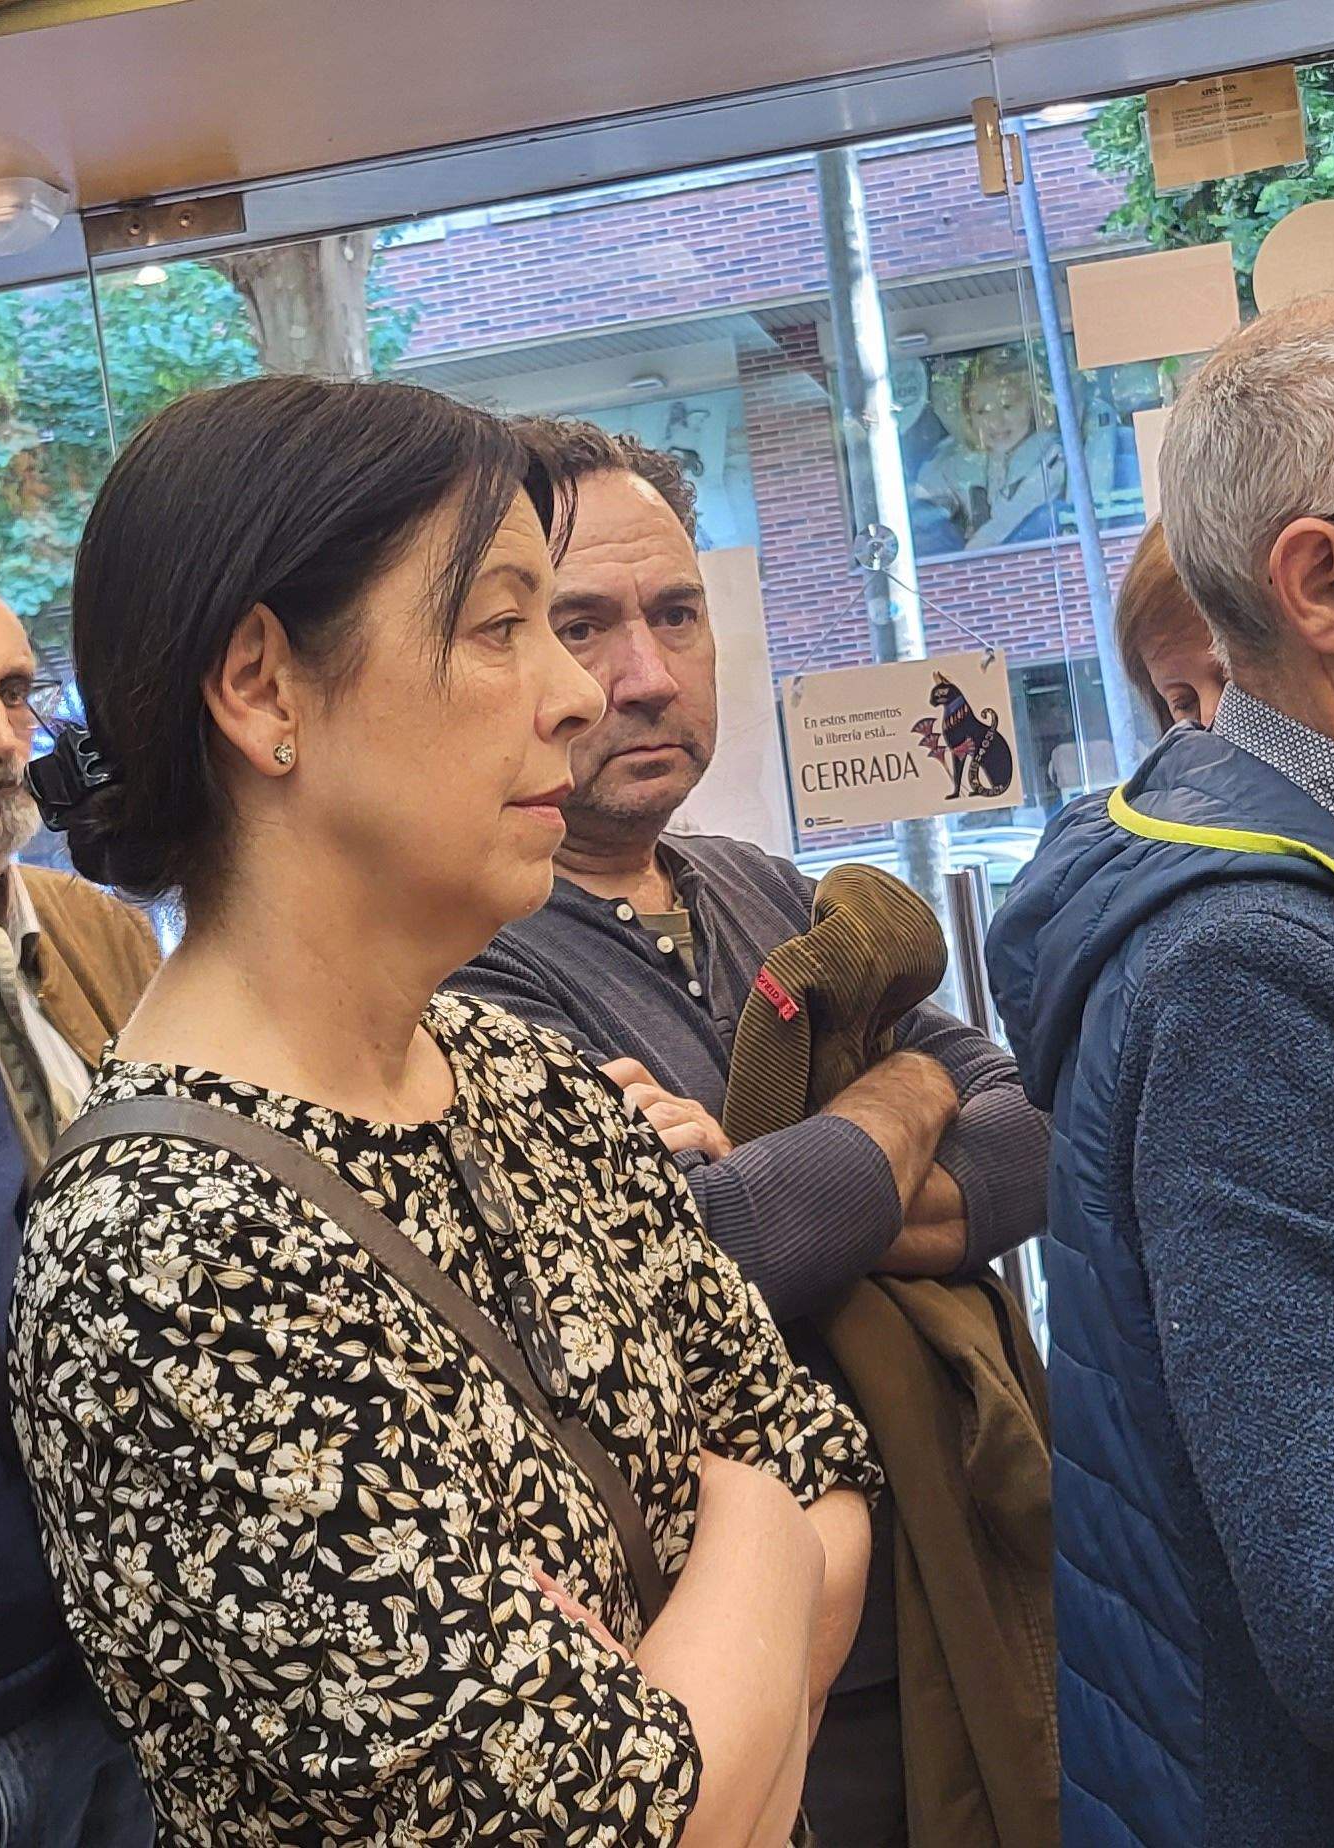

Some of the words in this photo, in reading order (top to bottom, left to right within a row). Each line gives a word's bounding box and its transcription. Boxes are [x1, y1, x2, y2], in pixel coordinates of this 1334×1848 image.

[803, 717, 818, 729] En
[820, 715, 847, 727] estos
[848, 707, 902, 723] momentos
[813, 734, 823, 746] la
[826, 729, 862, 745] librería
[864, 726, 896, 740] está...
[801, 751, 920, 793] CERRADA
